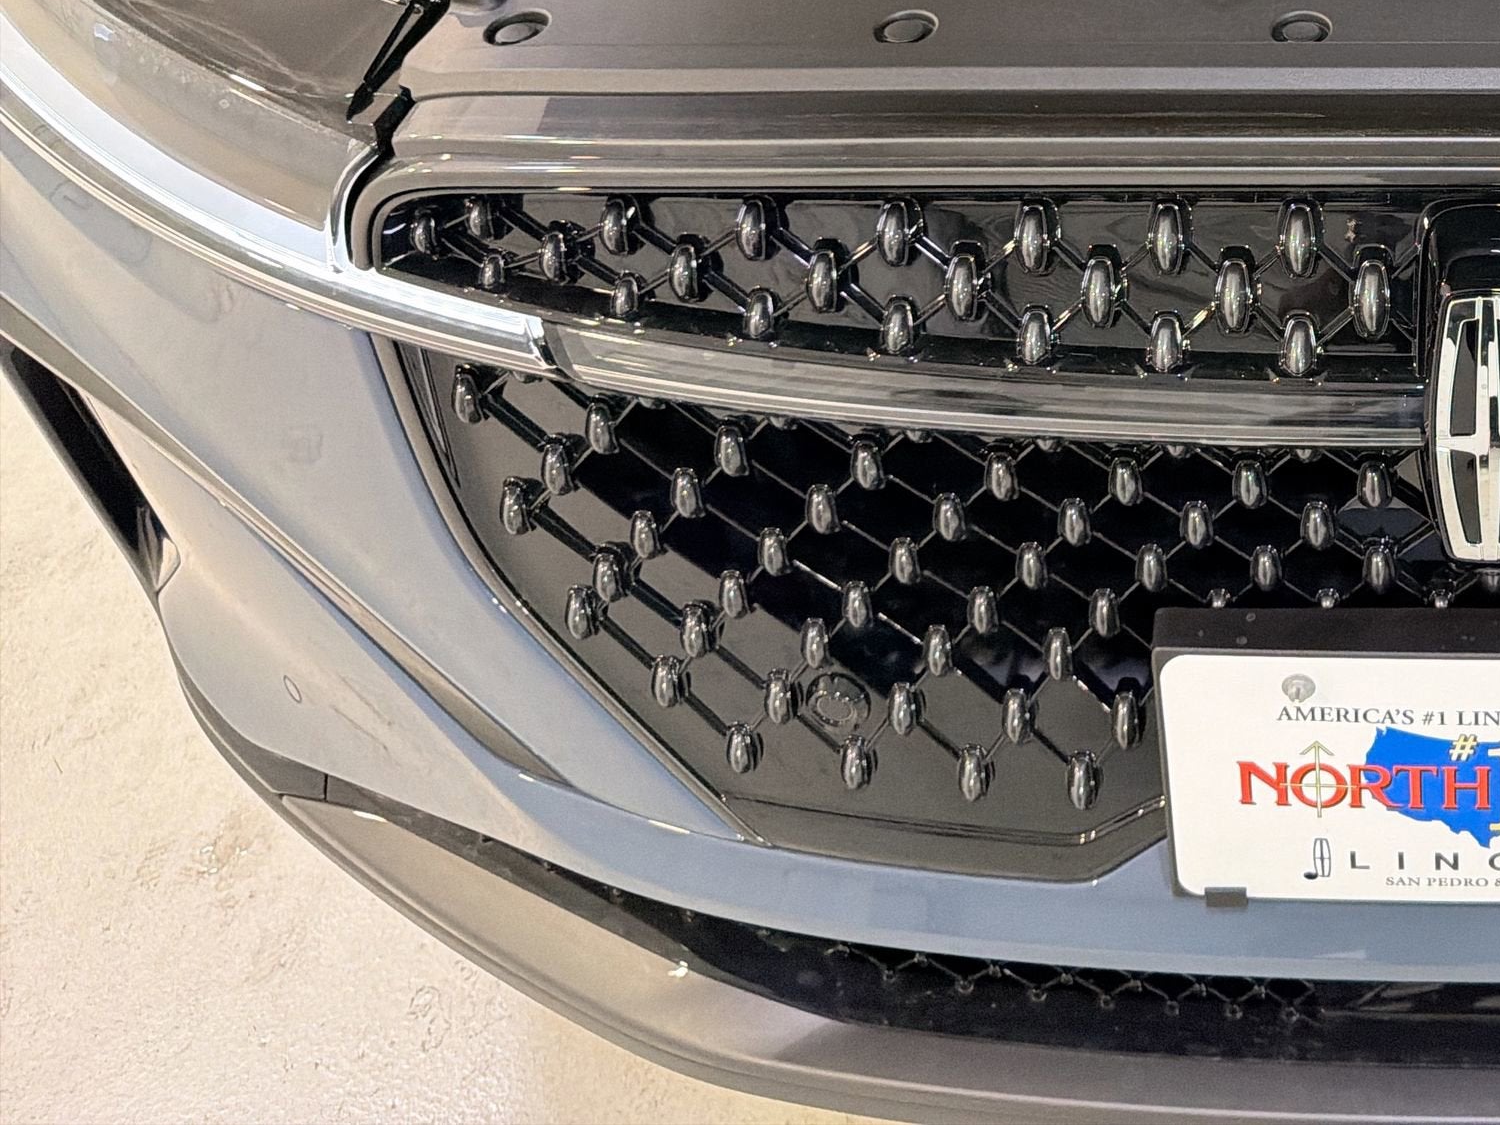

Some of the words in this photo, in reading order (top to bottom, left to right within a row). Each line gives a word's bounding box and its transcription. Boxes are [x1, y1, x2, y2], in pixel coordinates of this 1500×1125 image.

[1277, 706, 1415, 725] AMERICA'S
[1422, 711, 1448, 726] #1
[1236, 760, 1492, 810] NORTH
[1385, 876, 1423, 887] SAN
[1426, 876, 1489, 887] PEDRO
